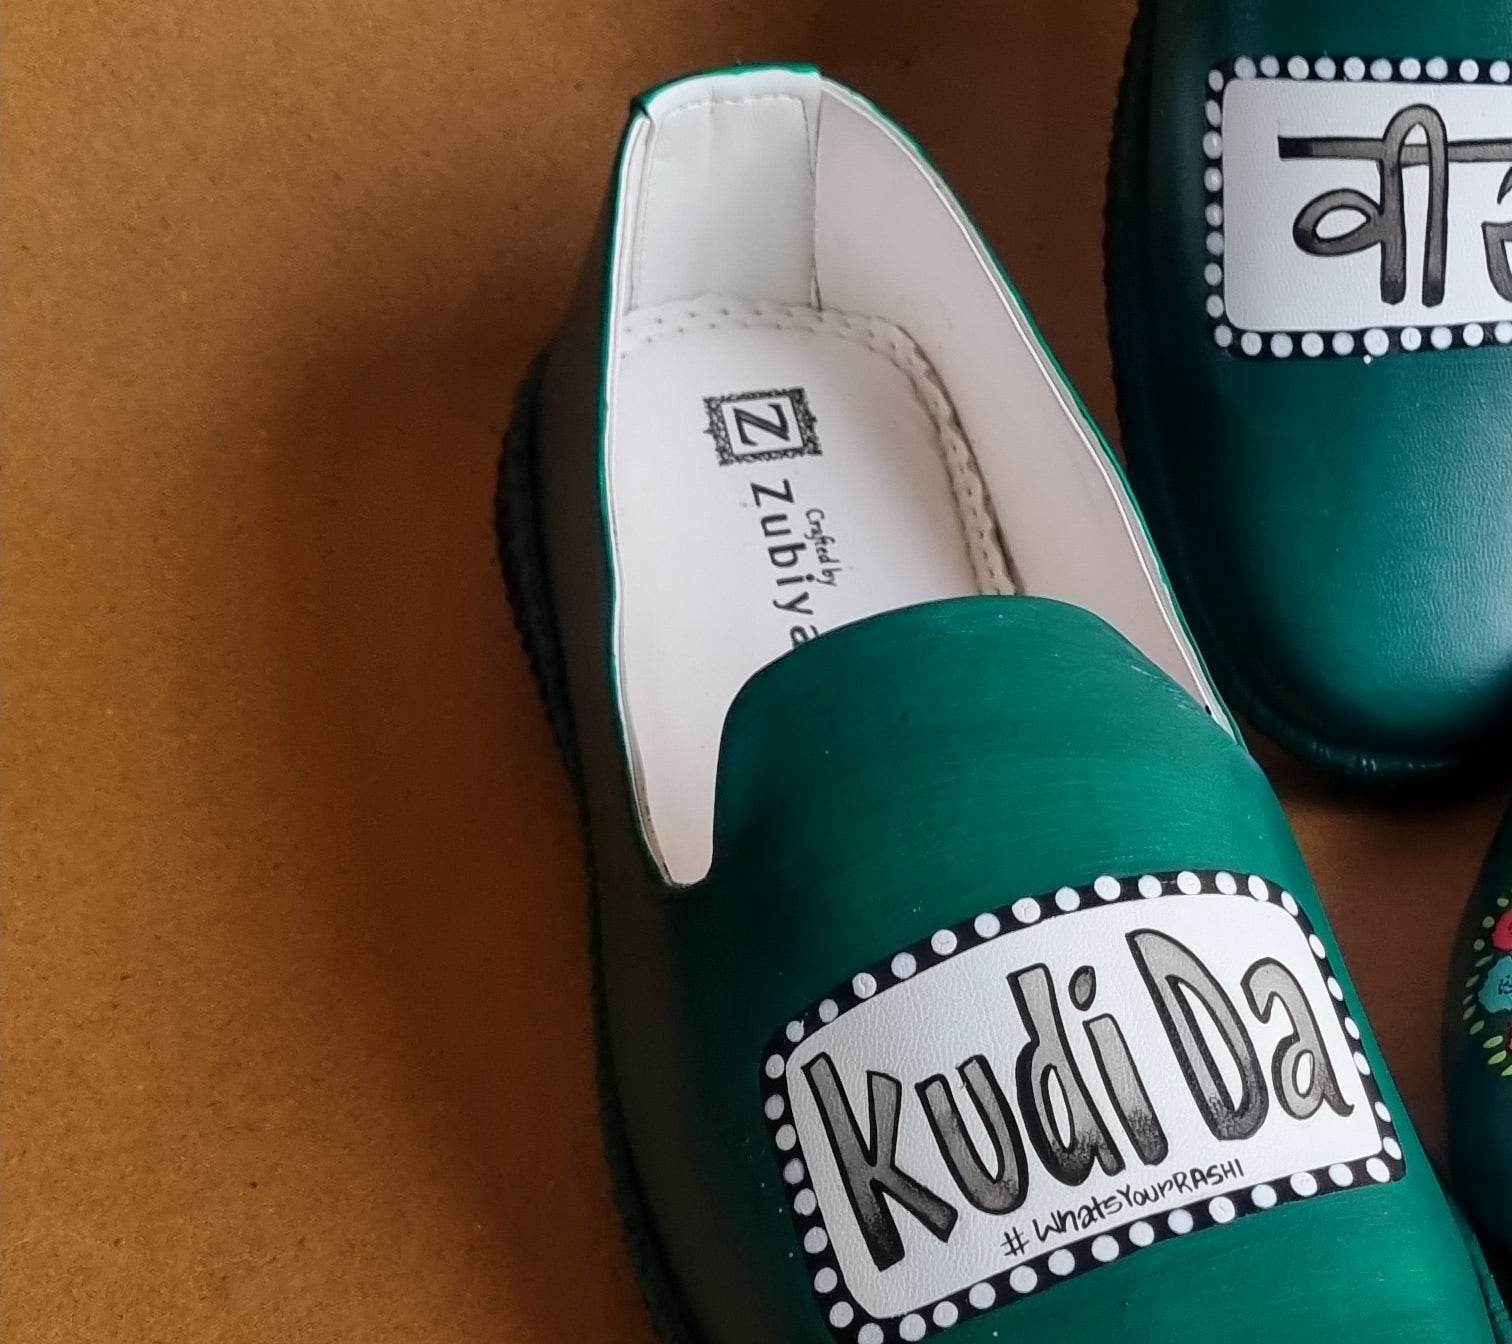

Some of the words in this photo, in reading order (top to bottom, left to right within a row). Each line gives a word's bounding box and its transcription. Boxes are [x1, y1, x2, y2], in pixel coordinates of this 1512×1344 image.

[803, 507, 840, 565] Crafted
[815, 566, 843, 587] by
[1124, 927, 1355, 1142] Da
